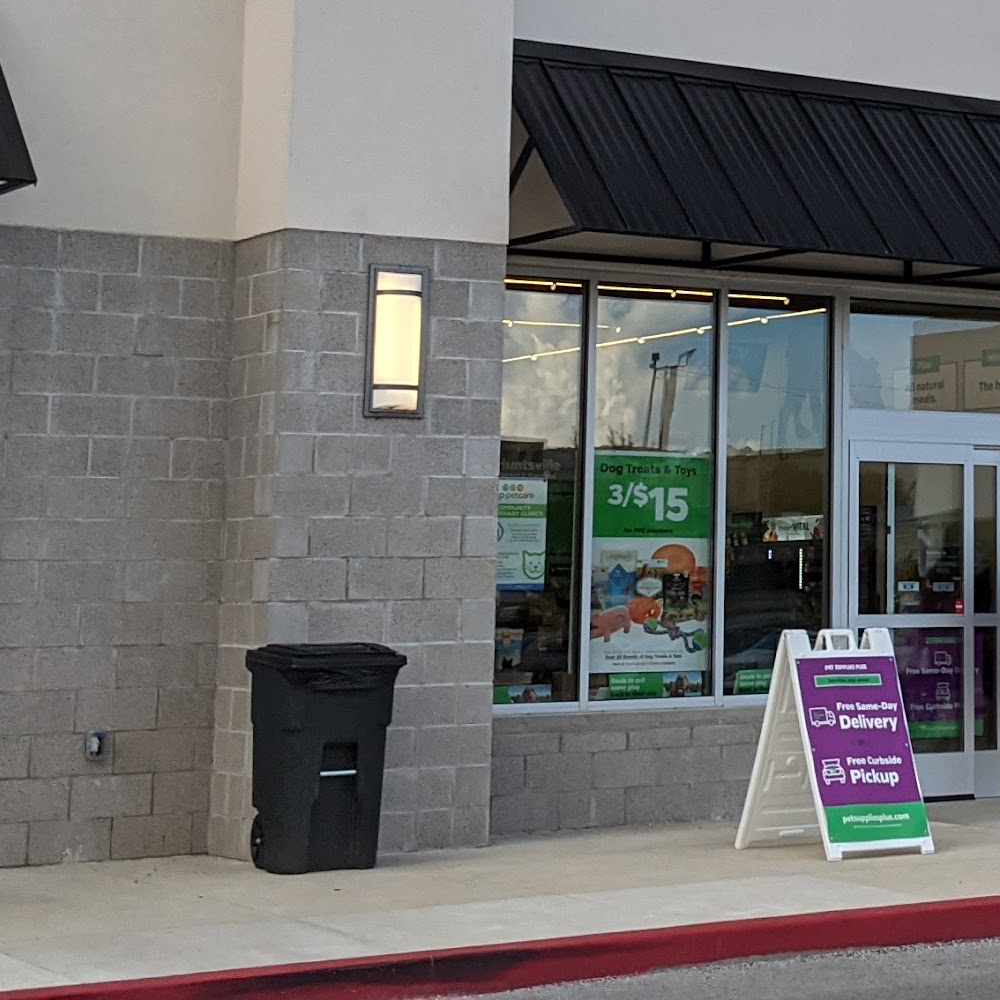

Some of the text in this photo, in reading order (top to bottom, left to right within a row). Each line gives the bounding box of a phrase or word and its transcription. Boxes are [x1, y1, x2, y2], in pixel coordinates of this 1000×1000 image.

[979, 381, 994, 391] The
[600, 463, 623, 475] Dog
[626, 463, 660, 474] Treats
[675, 465, 697, 477] Toys
[836, 701, 897, 712] Free Same-Day
[839, 714, 898, 732] Delivery
[846, 755, 902, 766] Free Curbside
[849, 768, 899, 787] Pickup
[842, 813, 910, 825] petsuppliesplus.com
